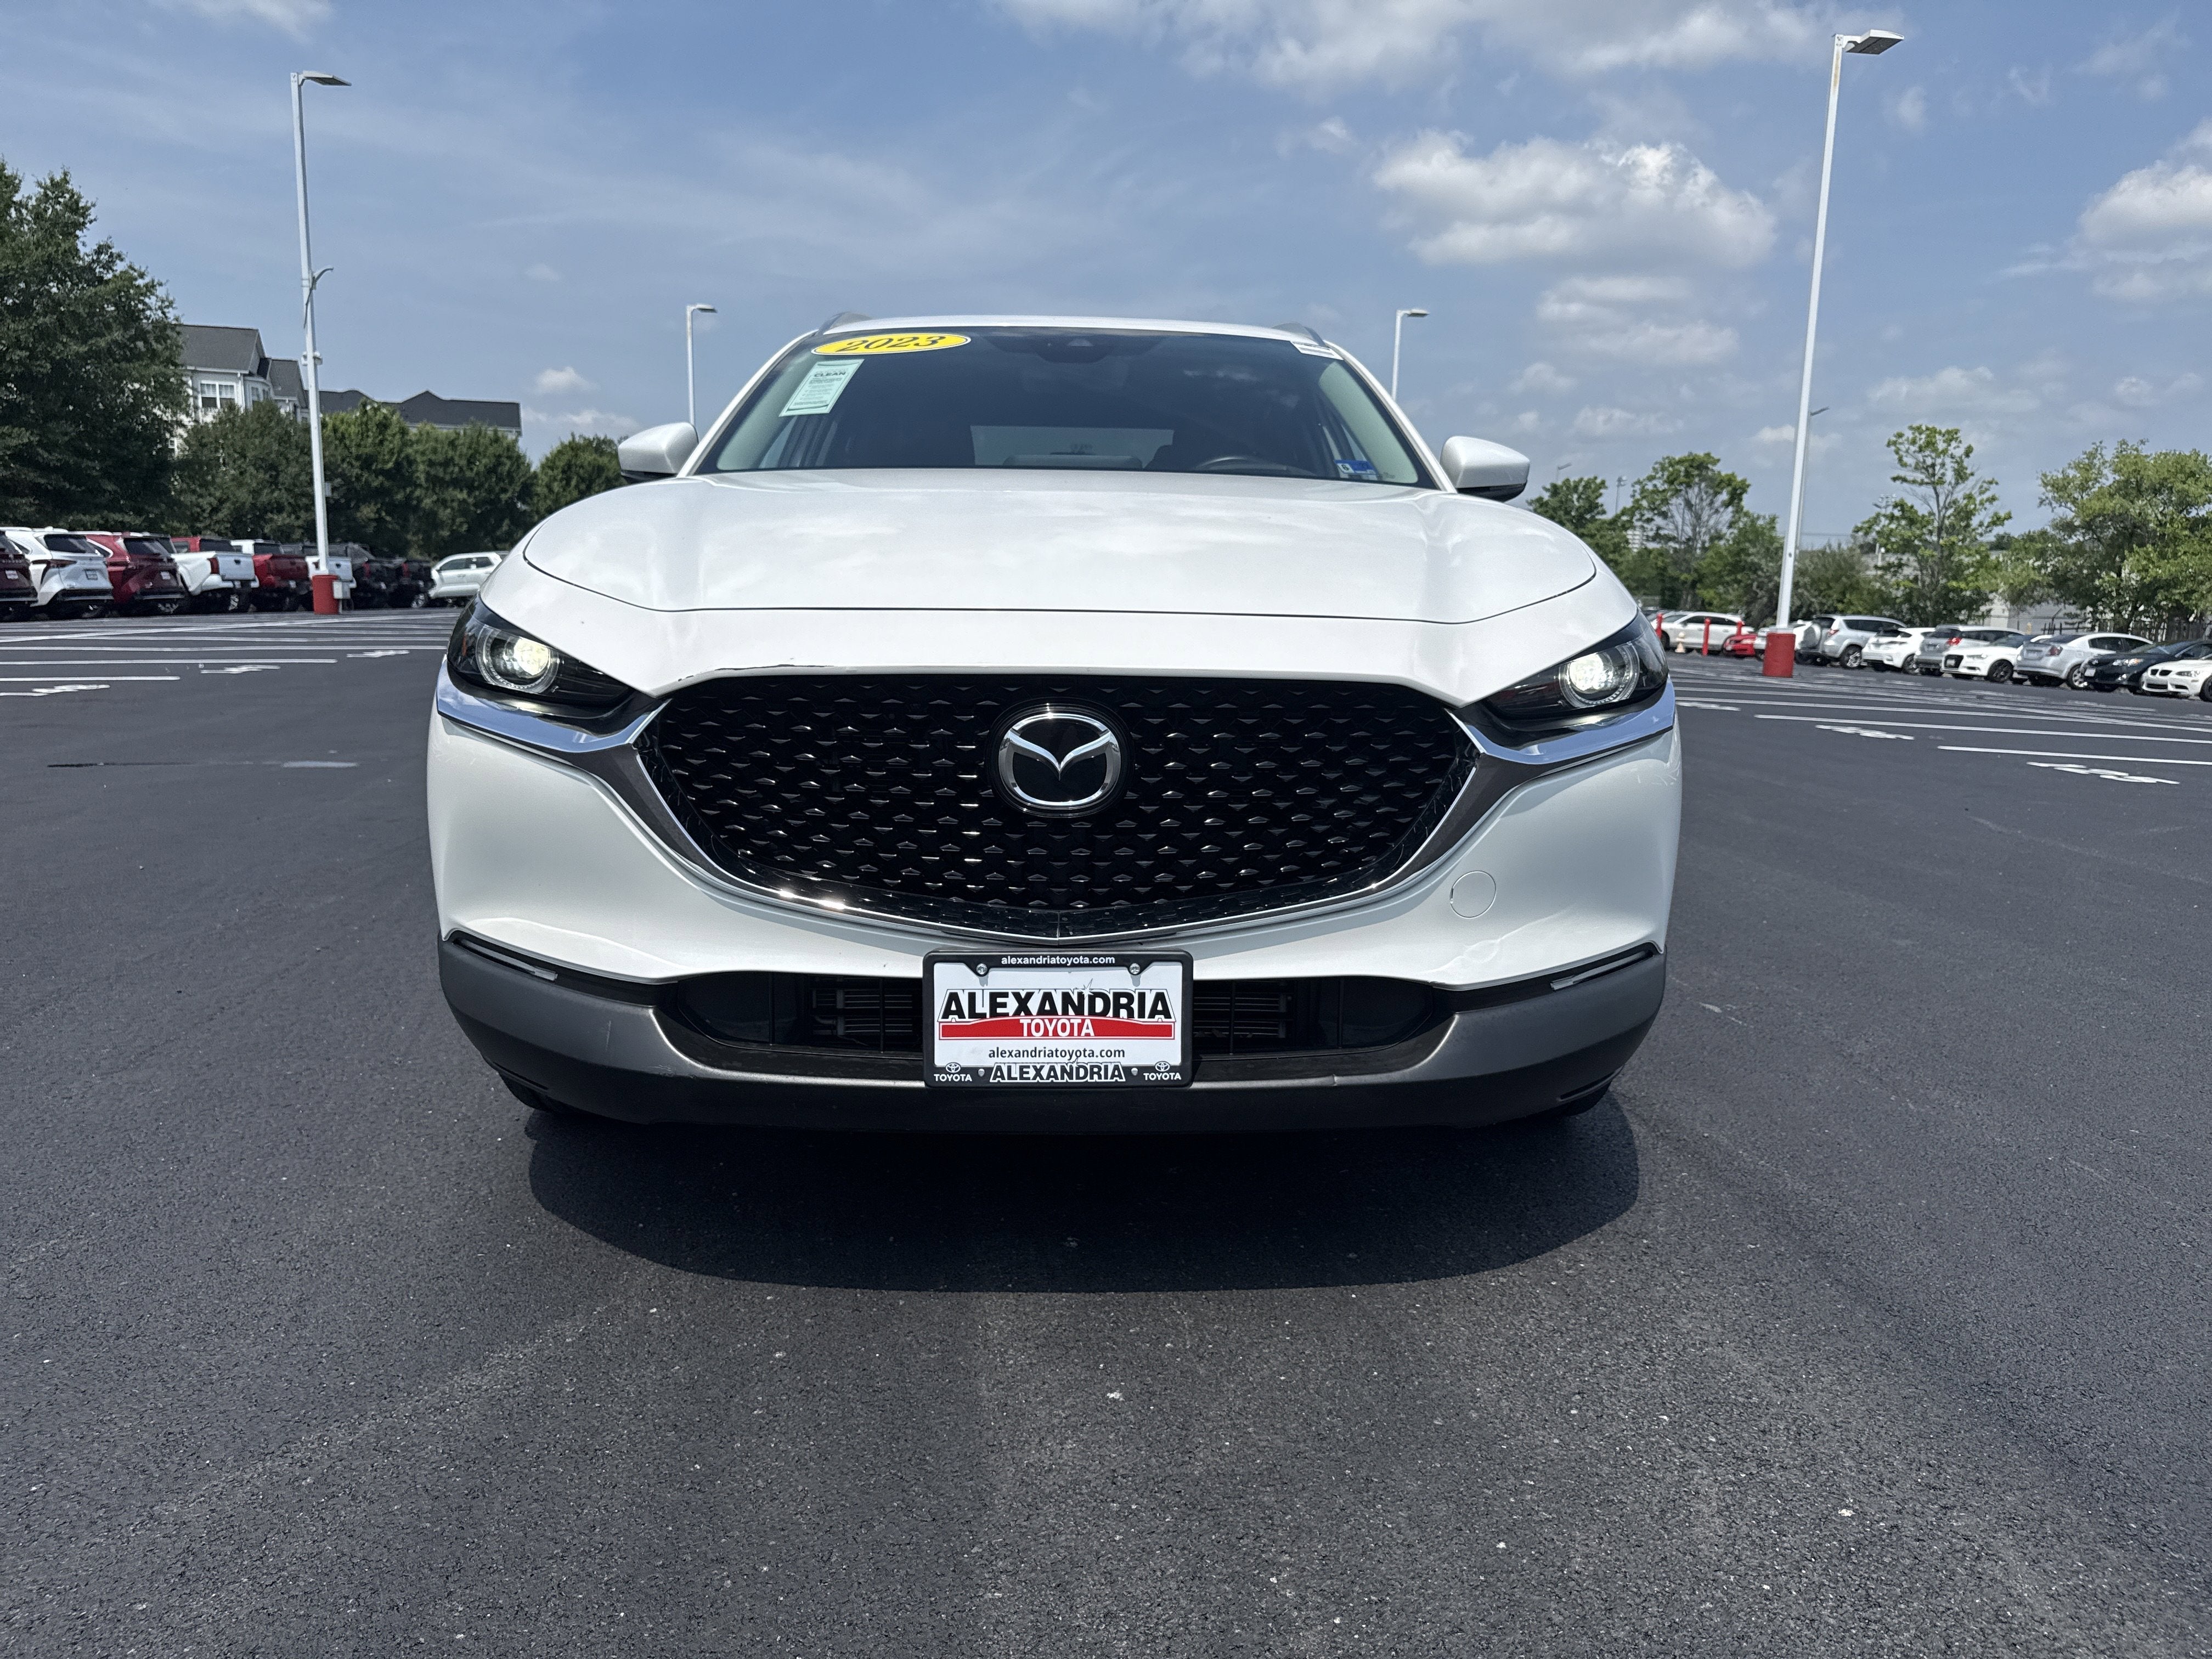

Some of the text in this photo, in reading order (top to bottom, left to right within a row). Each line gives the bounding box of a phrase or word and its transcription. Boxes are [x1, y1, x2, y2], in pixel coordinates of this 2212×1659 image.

[835, 336, 946, 353] 2023
[1001, 955, 1115, 966] alexandriatoyota.com
[941, 990, 1172, 1019] ALEXANDRIA
[1019, 1019, 1095, 1037] TOYOTA
[988, 1046, 1125, 1062] alexandriatoyota.com
[934, 1074, 972, 1082] TOYOTA
[990, 1063, 1125, 1082] ALEXANDRIA
[1143, 1071, 1181, 1081] TOYOTA
